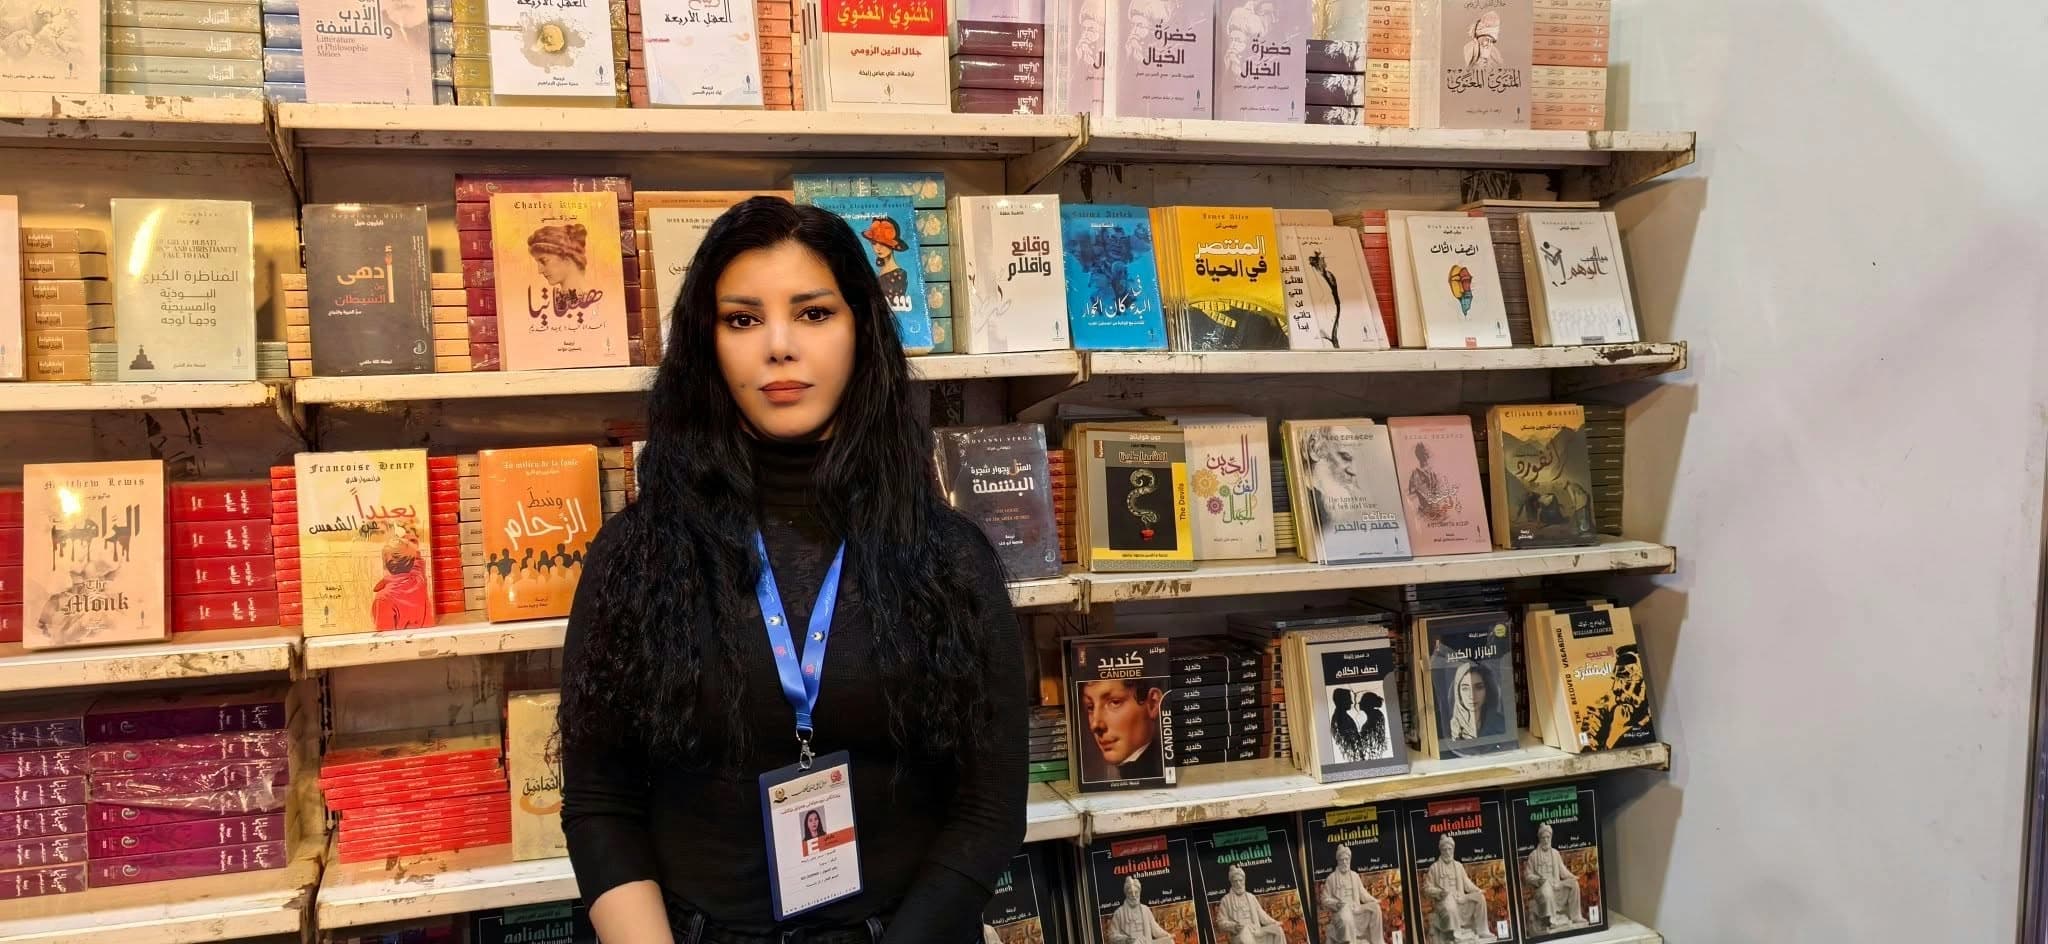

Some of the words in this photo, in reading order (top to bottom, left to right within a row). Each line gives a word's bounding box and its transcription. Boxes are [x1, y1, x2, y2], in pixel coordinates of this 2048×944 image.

[339, 4, 376, 22] الأدب
[316, 12, 393, 39] والفلسفة
[1012, 235, 1050, 256] وقائع
[1195, 235, 1266, 259] المنتصر
[336, 246, 395, 304] أدهى
[1008, 254, 1051, 281] وأقلام
[1195, 258, 1244, 282] الحياة
[1246, 255, 1268, 282] في
[528, 284, 603, 326] هيباتيا
[378, 462, 415, 470] Henry
[44, 479, 99, 489] Mtthew
[109, 477, 144, 487] Lewis
[309, 515, 358, 534] الشمس
[64, 592, 129, 615] Monk
[1556, 628, 1569, 669] VAGABOND
[1097, 651, 1144, 671] كنديد
[1335, 666, 1359, 678] الكلام
[1360, 664, 1379, 674] نصف
[1100, 669, 1142, 679] CANDIDE
[1565, 673, 1578, 705] BELOVED
[1574, 711, 1582, 725] THE
[1162, 709, 1175, 760] CANDIDE
